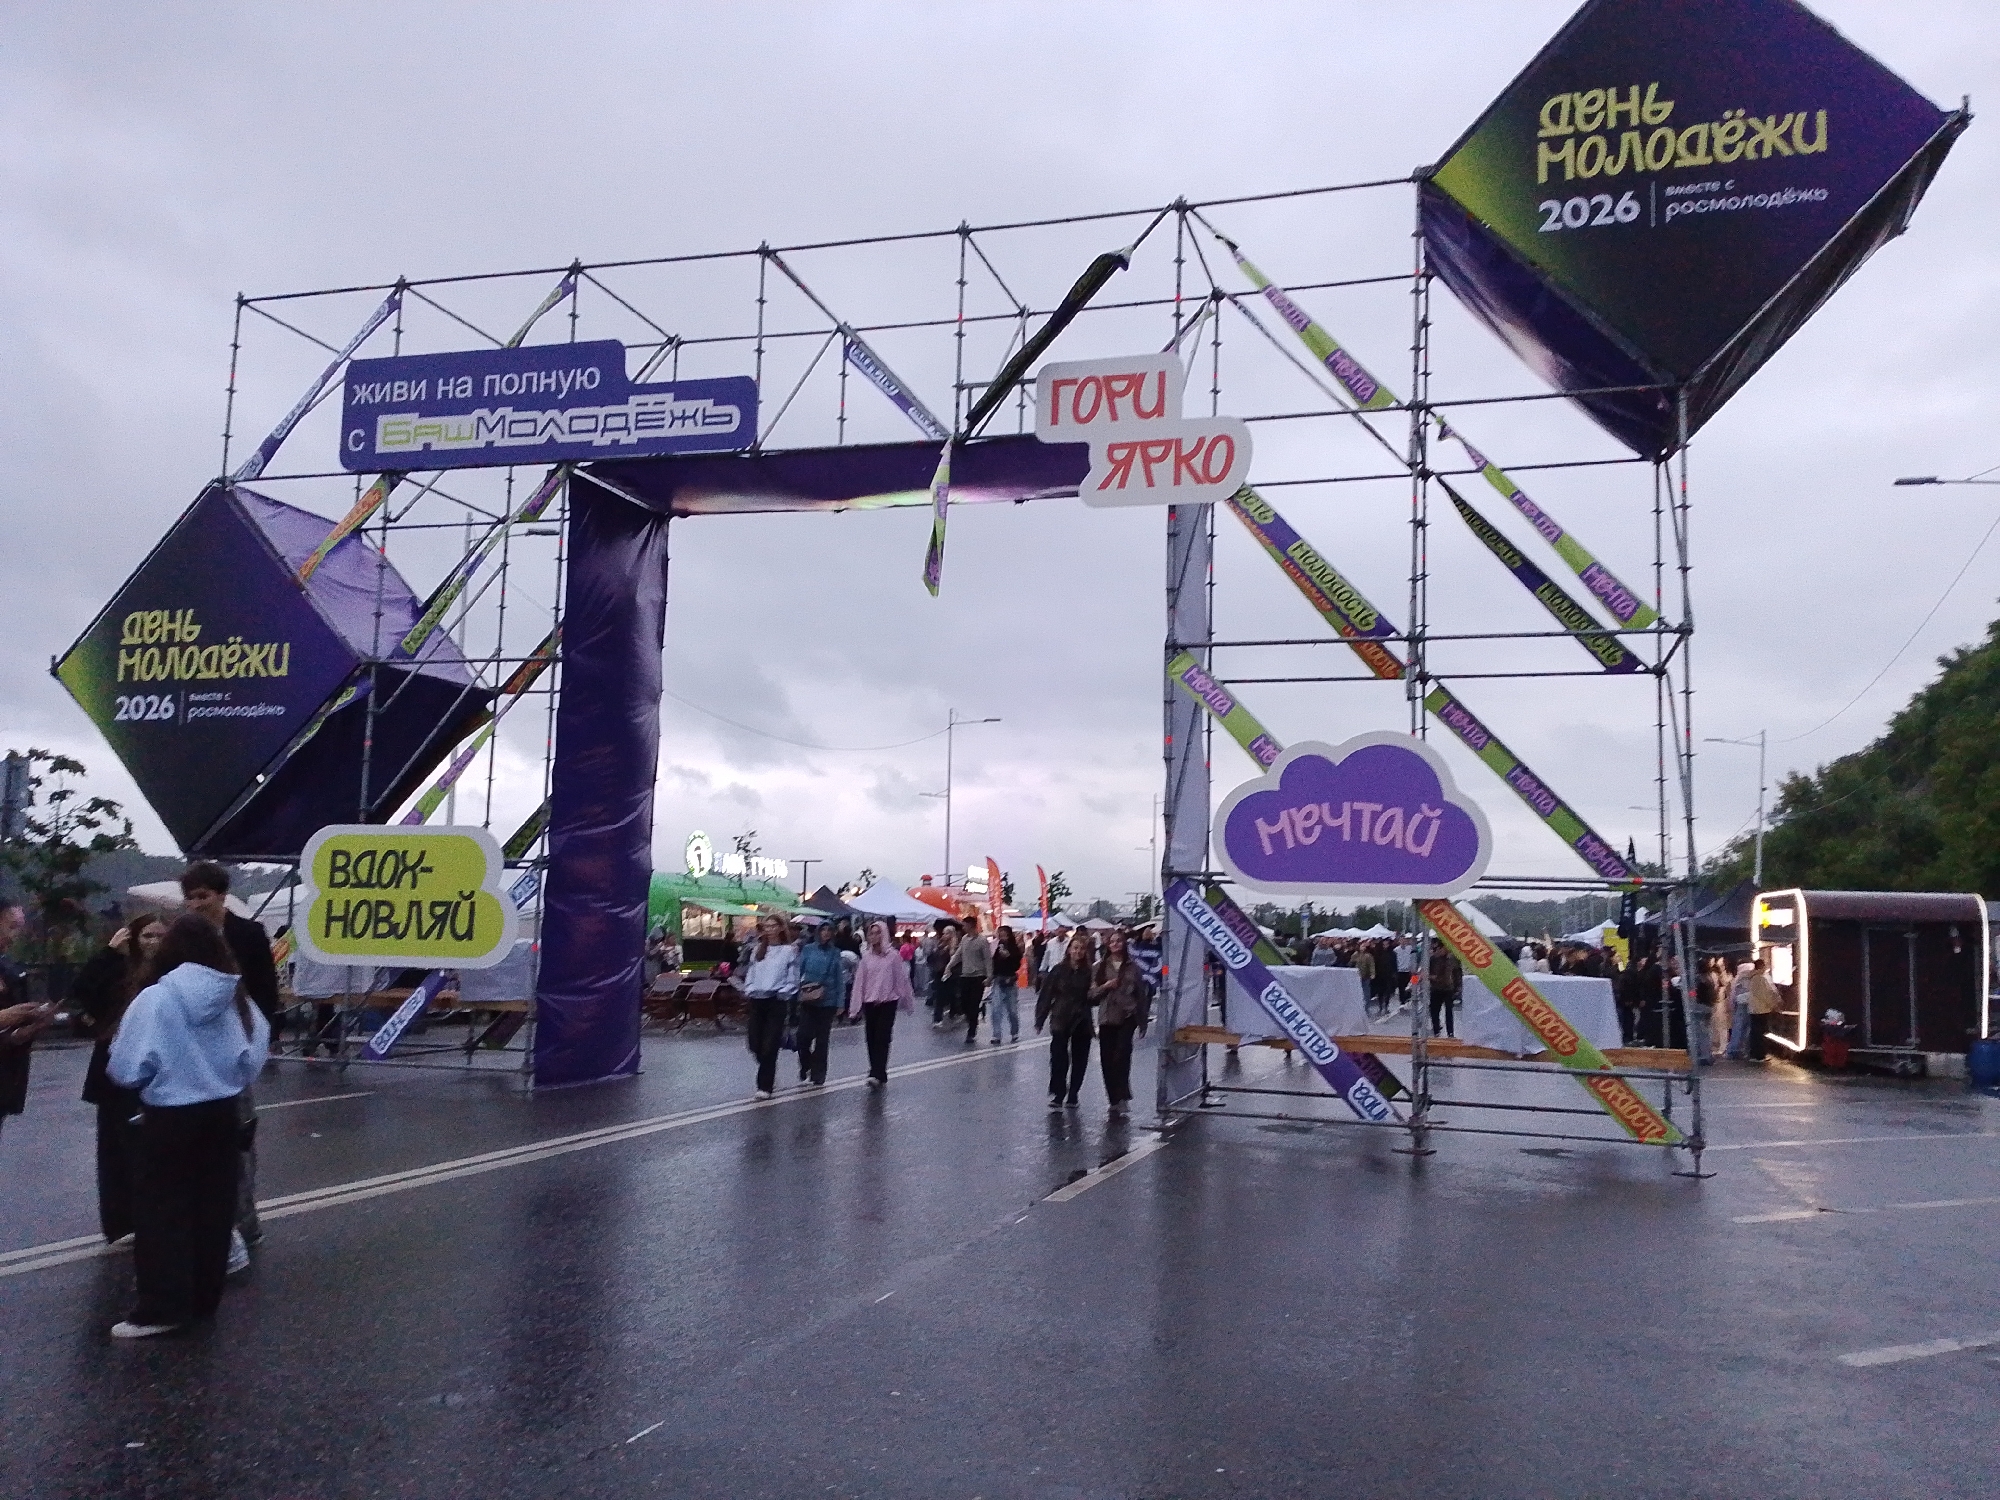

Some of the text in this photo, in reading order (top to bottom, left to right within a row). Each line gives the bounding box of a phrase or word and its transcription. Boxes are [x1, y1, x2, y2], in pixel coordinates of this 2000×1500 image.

[1665, 179, 1736, 197] вместе с
[1538, 191, 1641, 233] 2026
[351, 378, 427, 406] живи
[437, 375, 473, 400] на
[482, 366, 601, 401] полную
[1051, 370, 1166, 426] ГОРИ
[347, 428, 364, 451] с
[1097, 434, 1236, 491] ЯРКО
[114, 694, 175, 721] 2026
[329, 850, 433, 889] ВДОХ-
[324, 890, 476, 941] НОВЛЯЙ
